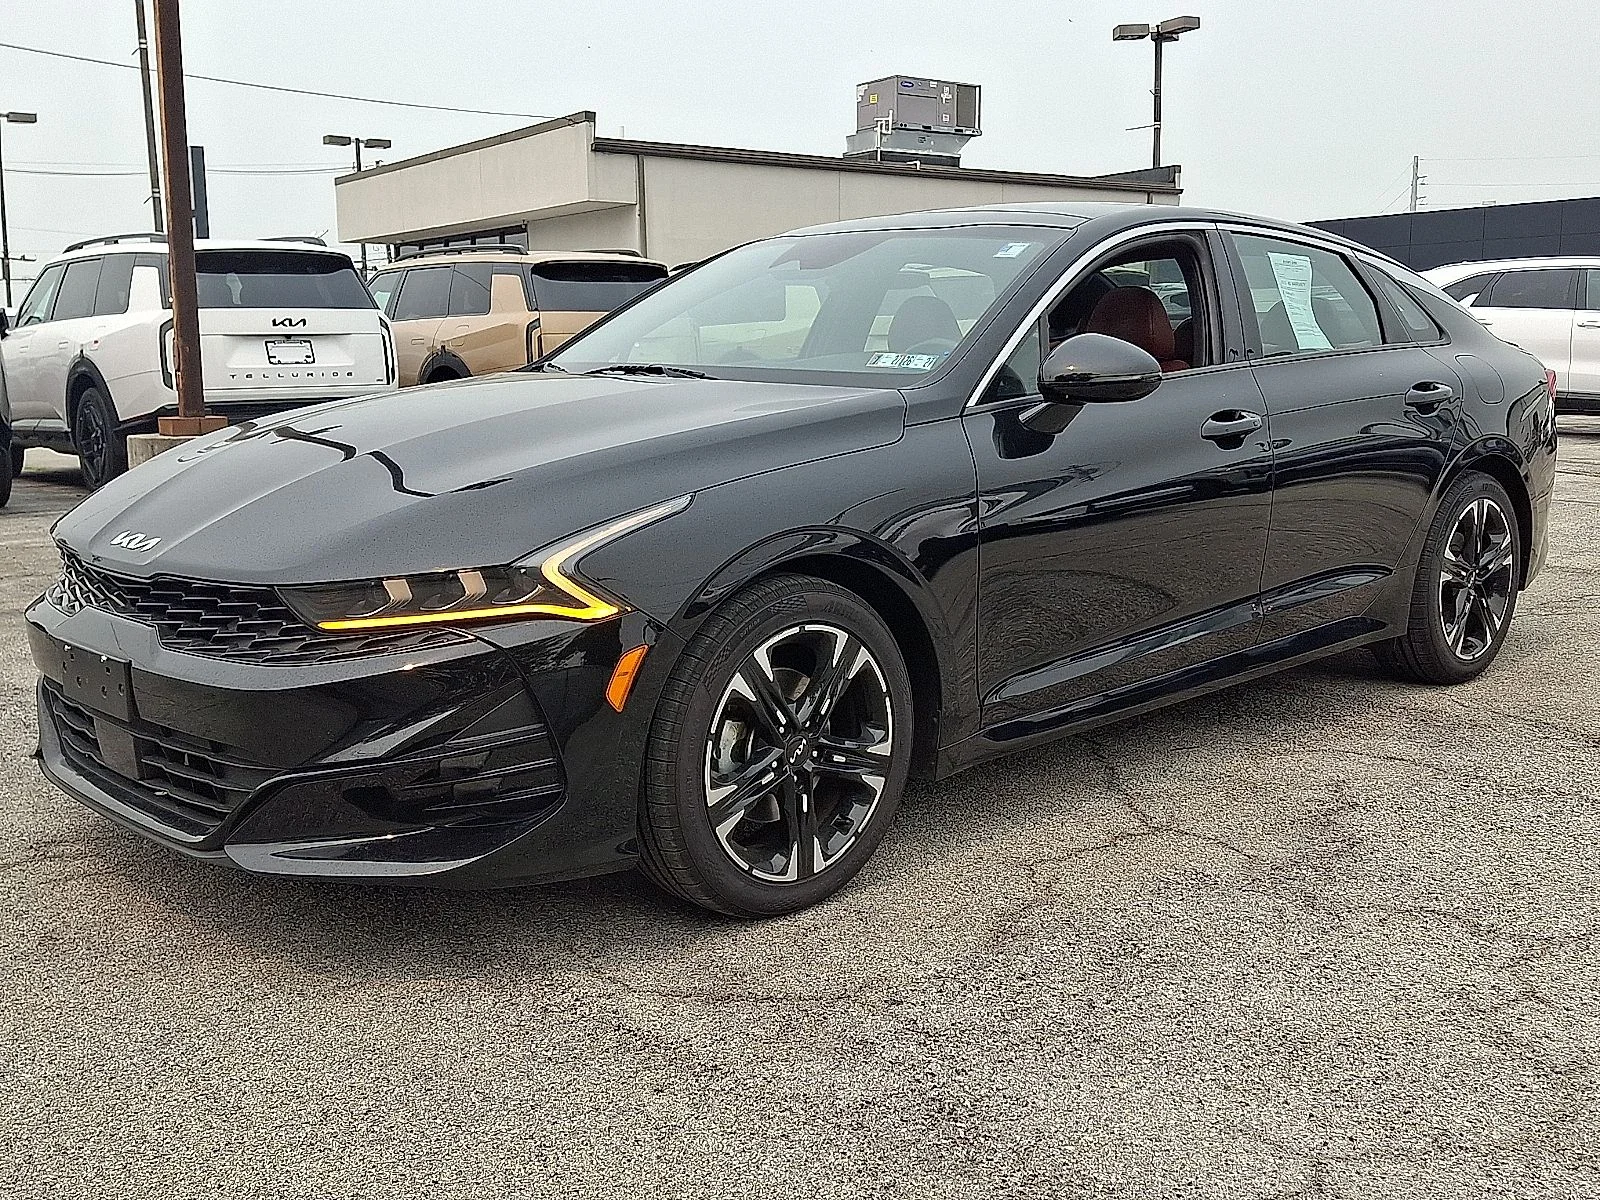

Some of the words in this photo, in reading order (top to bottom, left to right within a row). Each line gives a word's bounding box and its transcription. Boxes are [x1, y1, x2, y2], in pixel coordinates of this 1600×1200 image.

[272, 318, 306, 327] KIA
[230, 371, 353, 379] TELLURIDE
[110, 530, 162, 552] KIA
